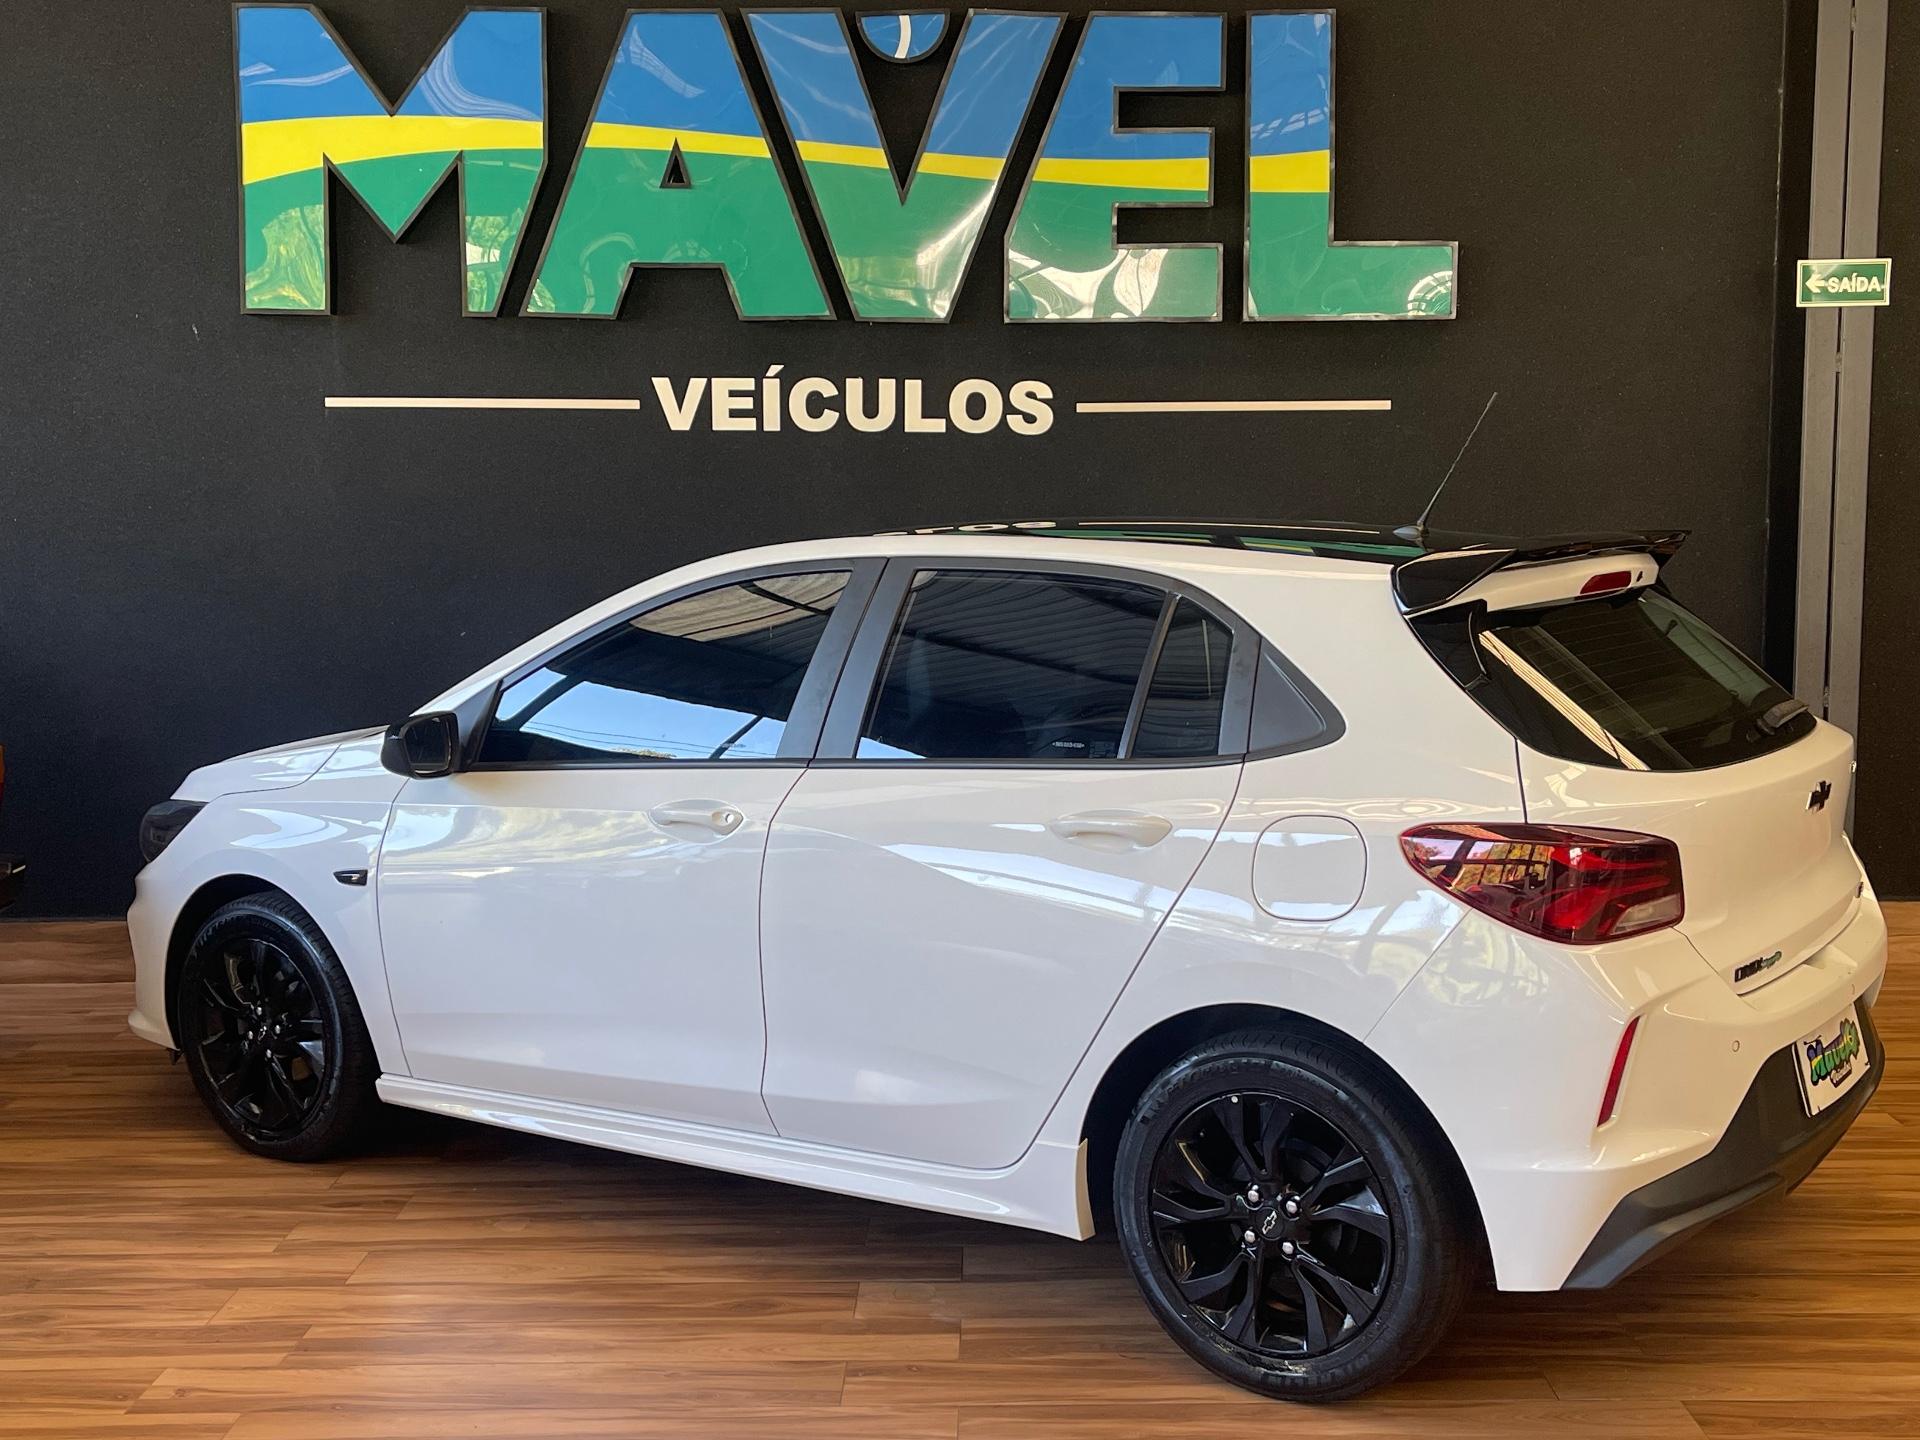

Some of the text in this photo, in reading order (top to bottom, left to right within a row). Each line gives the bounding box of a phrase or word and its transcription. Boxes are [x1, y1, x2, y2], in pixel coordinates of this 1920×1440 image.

[232, 4, 1458, 322] MAVEL
[1827, 273, 1881, 293] SAÍDA
[651, 365, 1055, 435] VEÍCULOS
